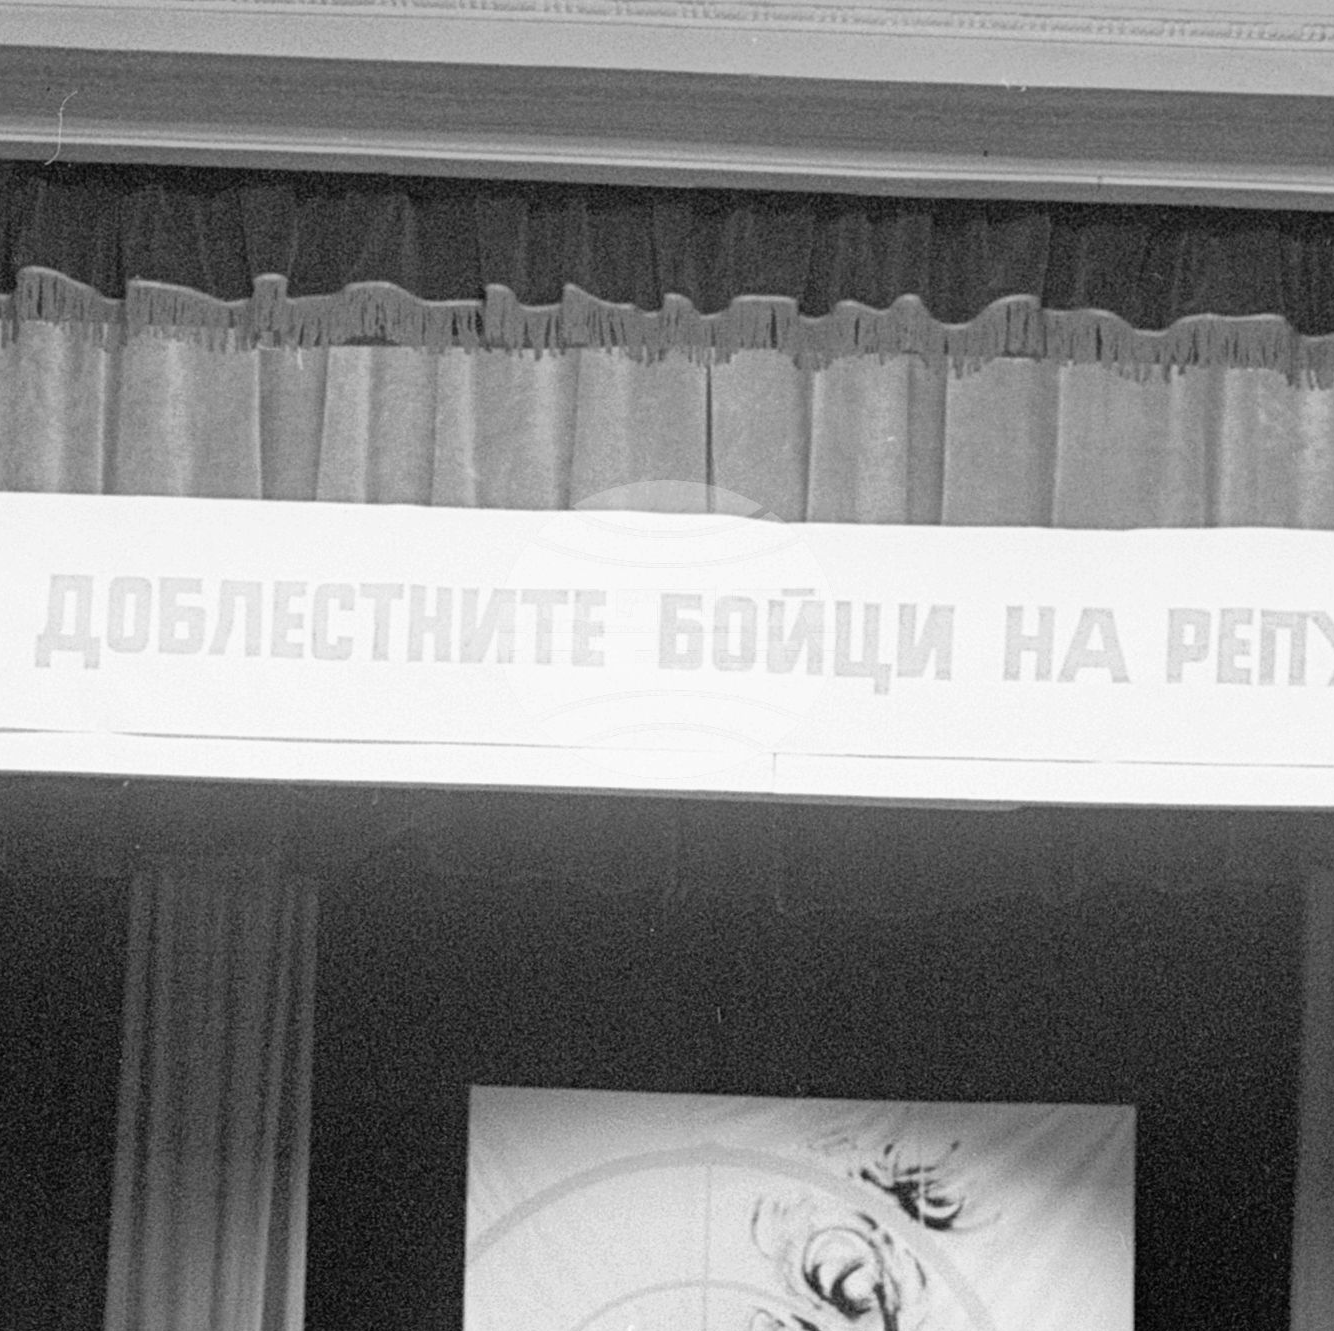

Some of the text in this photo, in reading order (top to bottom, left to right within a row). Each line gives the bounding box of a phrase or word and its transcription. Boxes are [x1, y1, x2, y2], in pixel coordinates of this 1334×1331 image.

[35, 573, 605, 669] ДОБЛЕСТНИТЕ
[658, 587, 954, 696] БОЙЦИ
[1003, 605, 1131, 684] НА
